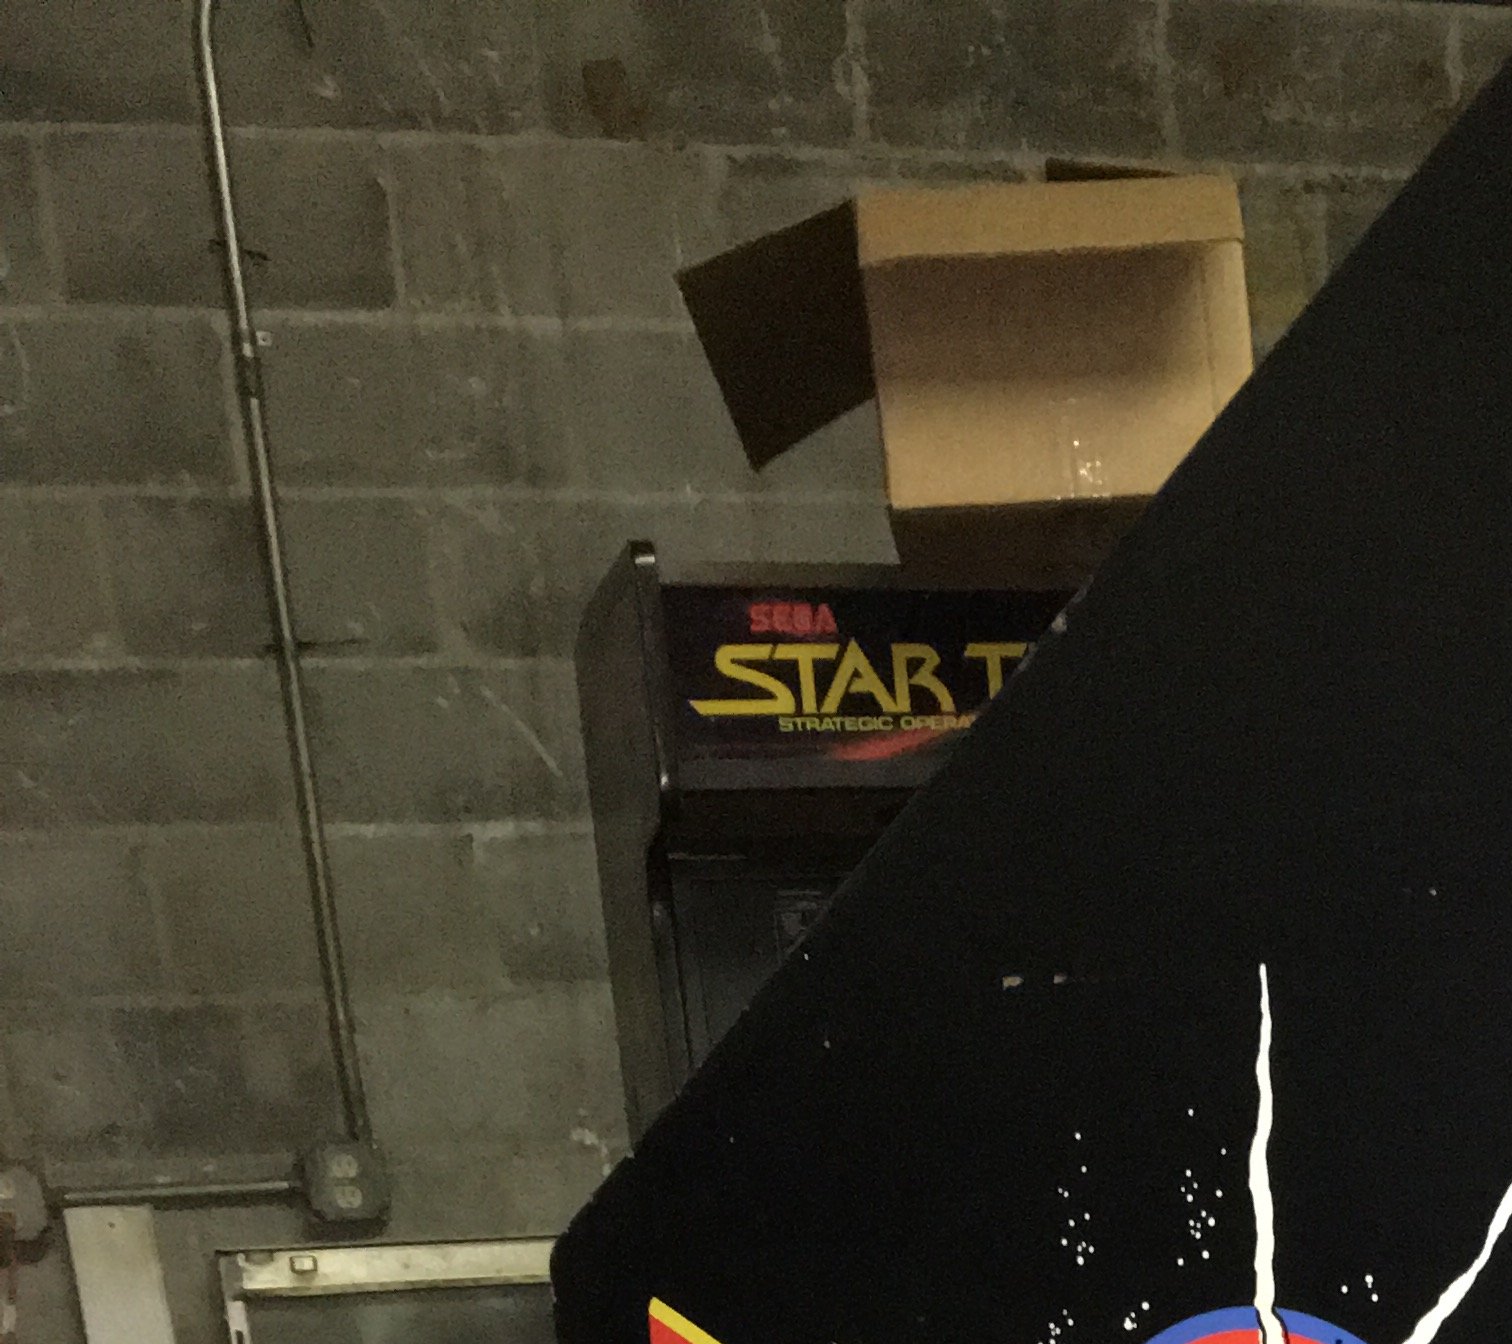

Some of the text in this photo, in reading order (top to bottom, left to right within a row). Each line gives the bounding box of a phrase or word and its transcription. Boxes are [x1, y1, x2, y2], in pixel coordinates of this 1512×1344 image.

[749, 602, 838, 635] SEGA
[688, 637, 1031, 716] STAR T
[778, 715, 894, 732] STRATEGIC
